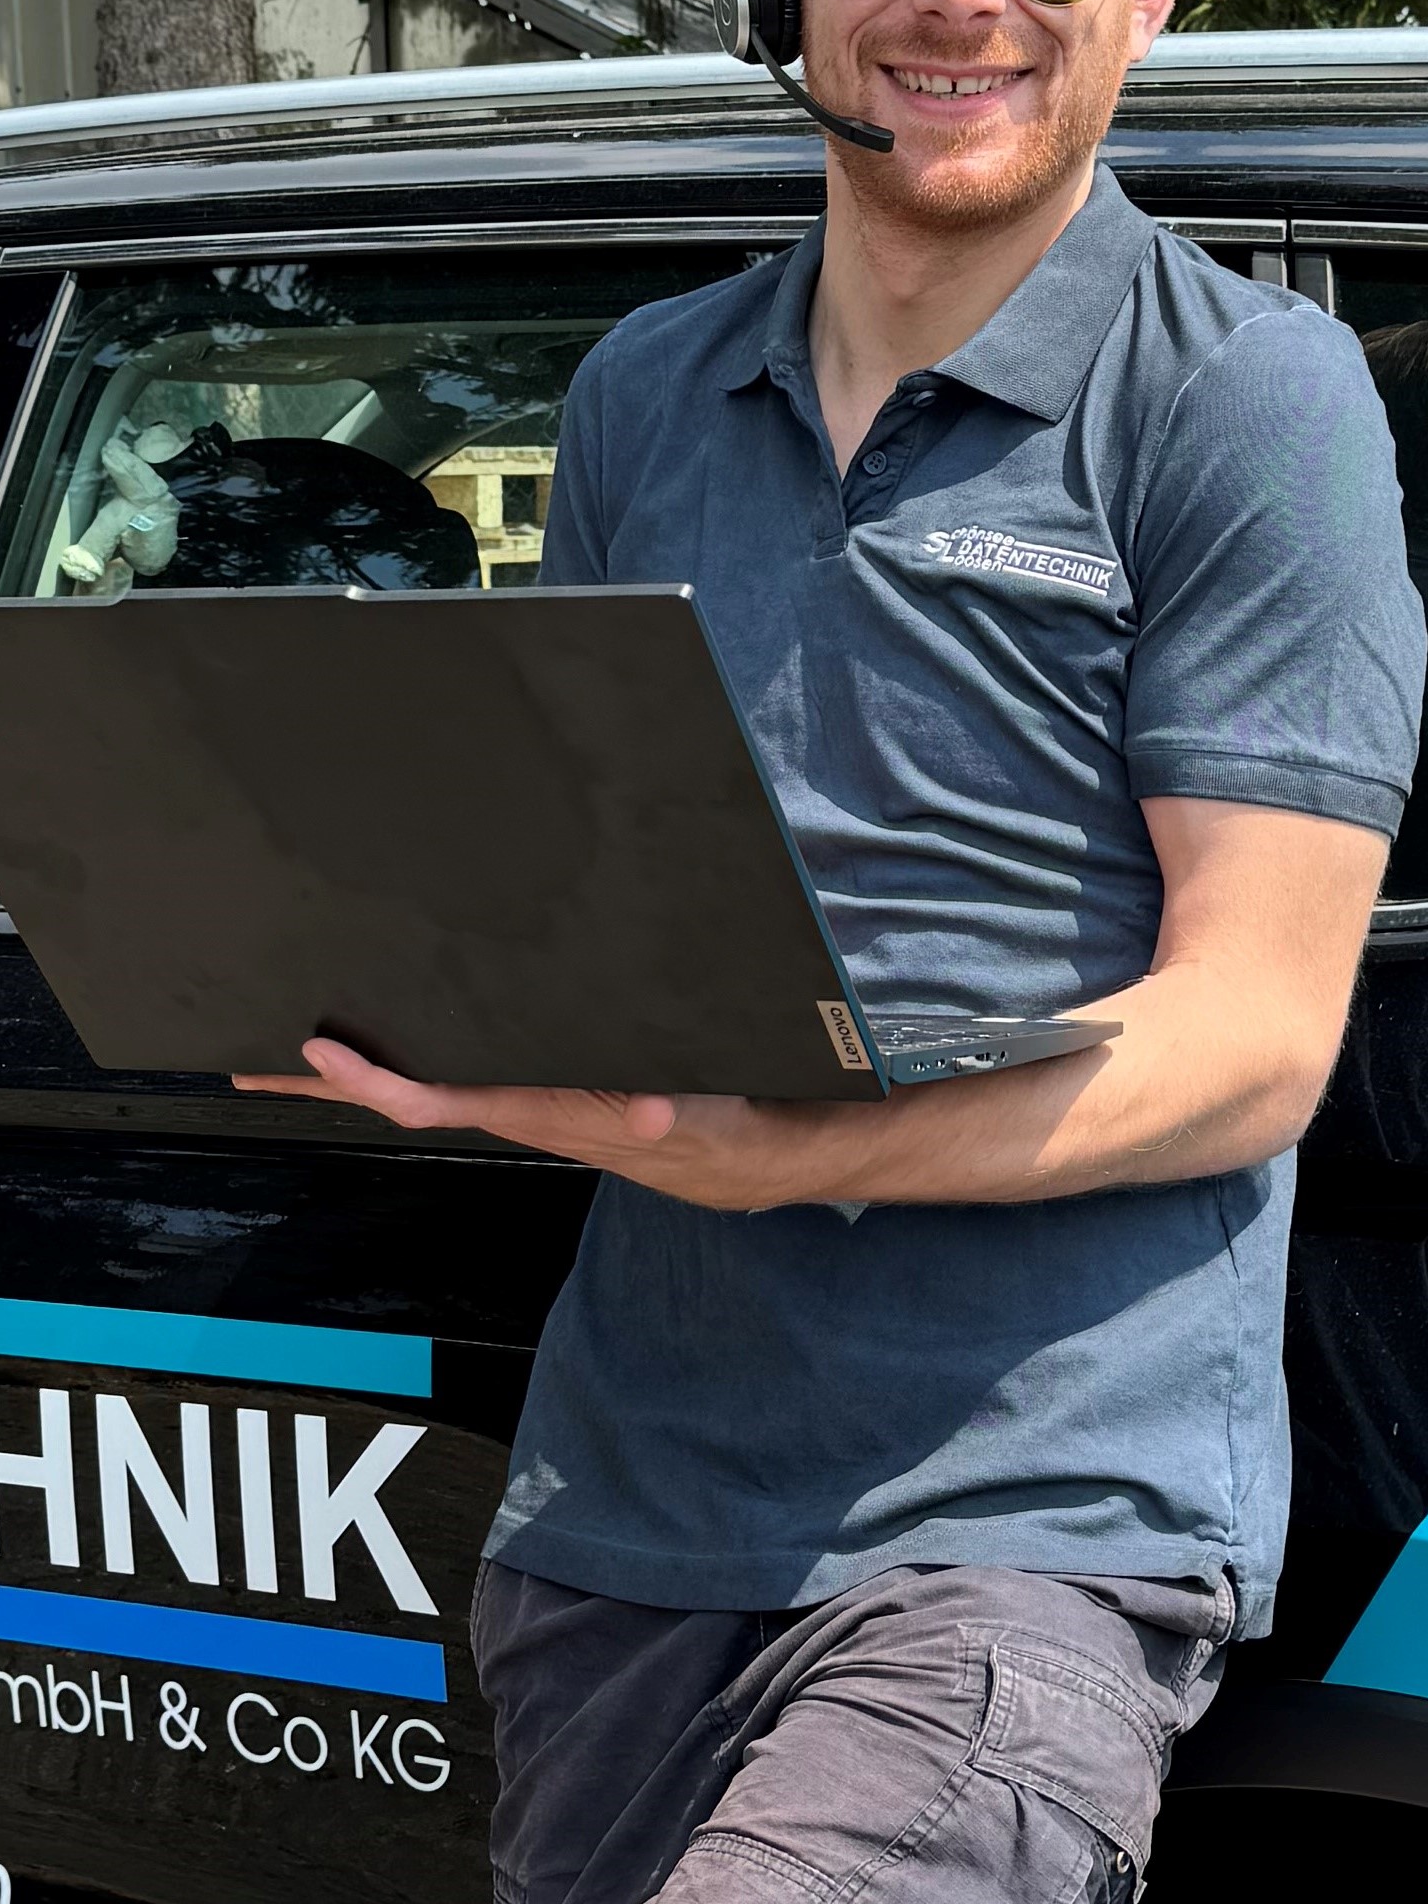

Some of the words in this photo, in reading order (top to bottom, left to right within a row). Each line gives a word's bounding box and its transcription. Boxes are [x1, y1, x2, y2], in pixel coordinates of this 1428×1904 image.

[958, 541, 1114, 590] DATENTECHNIK
[830, 1006, 863, 1065] Lenovo
[159, 1681, 207, 1752] &
[226, 1692, 328, 1772] Co
[350, 1708, 451, 1793] KG
